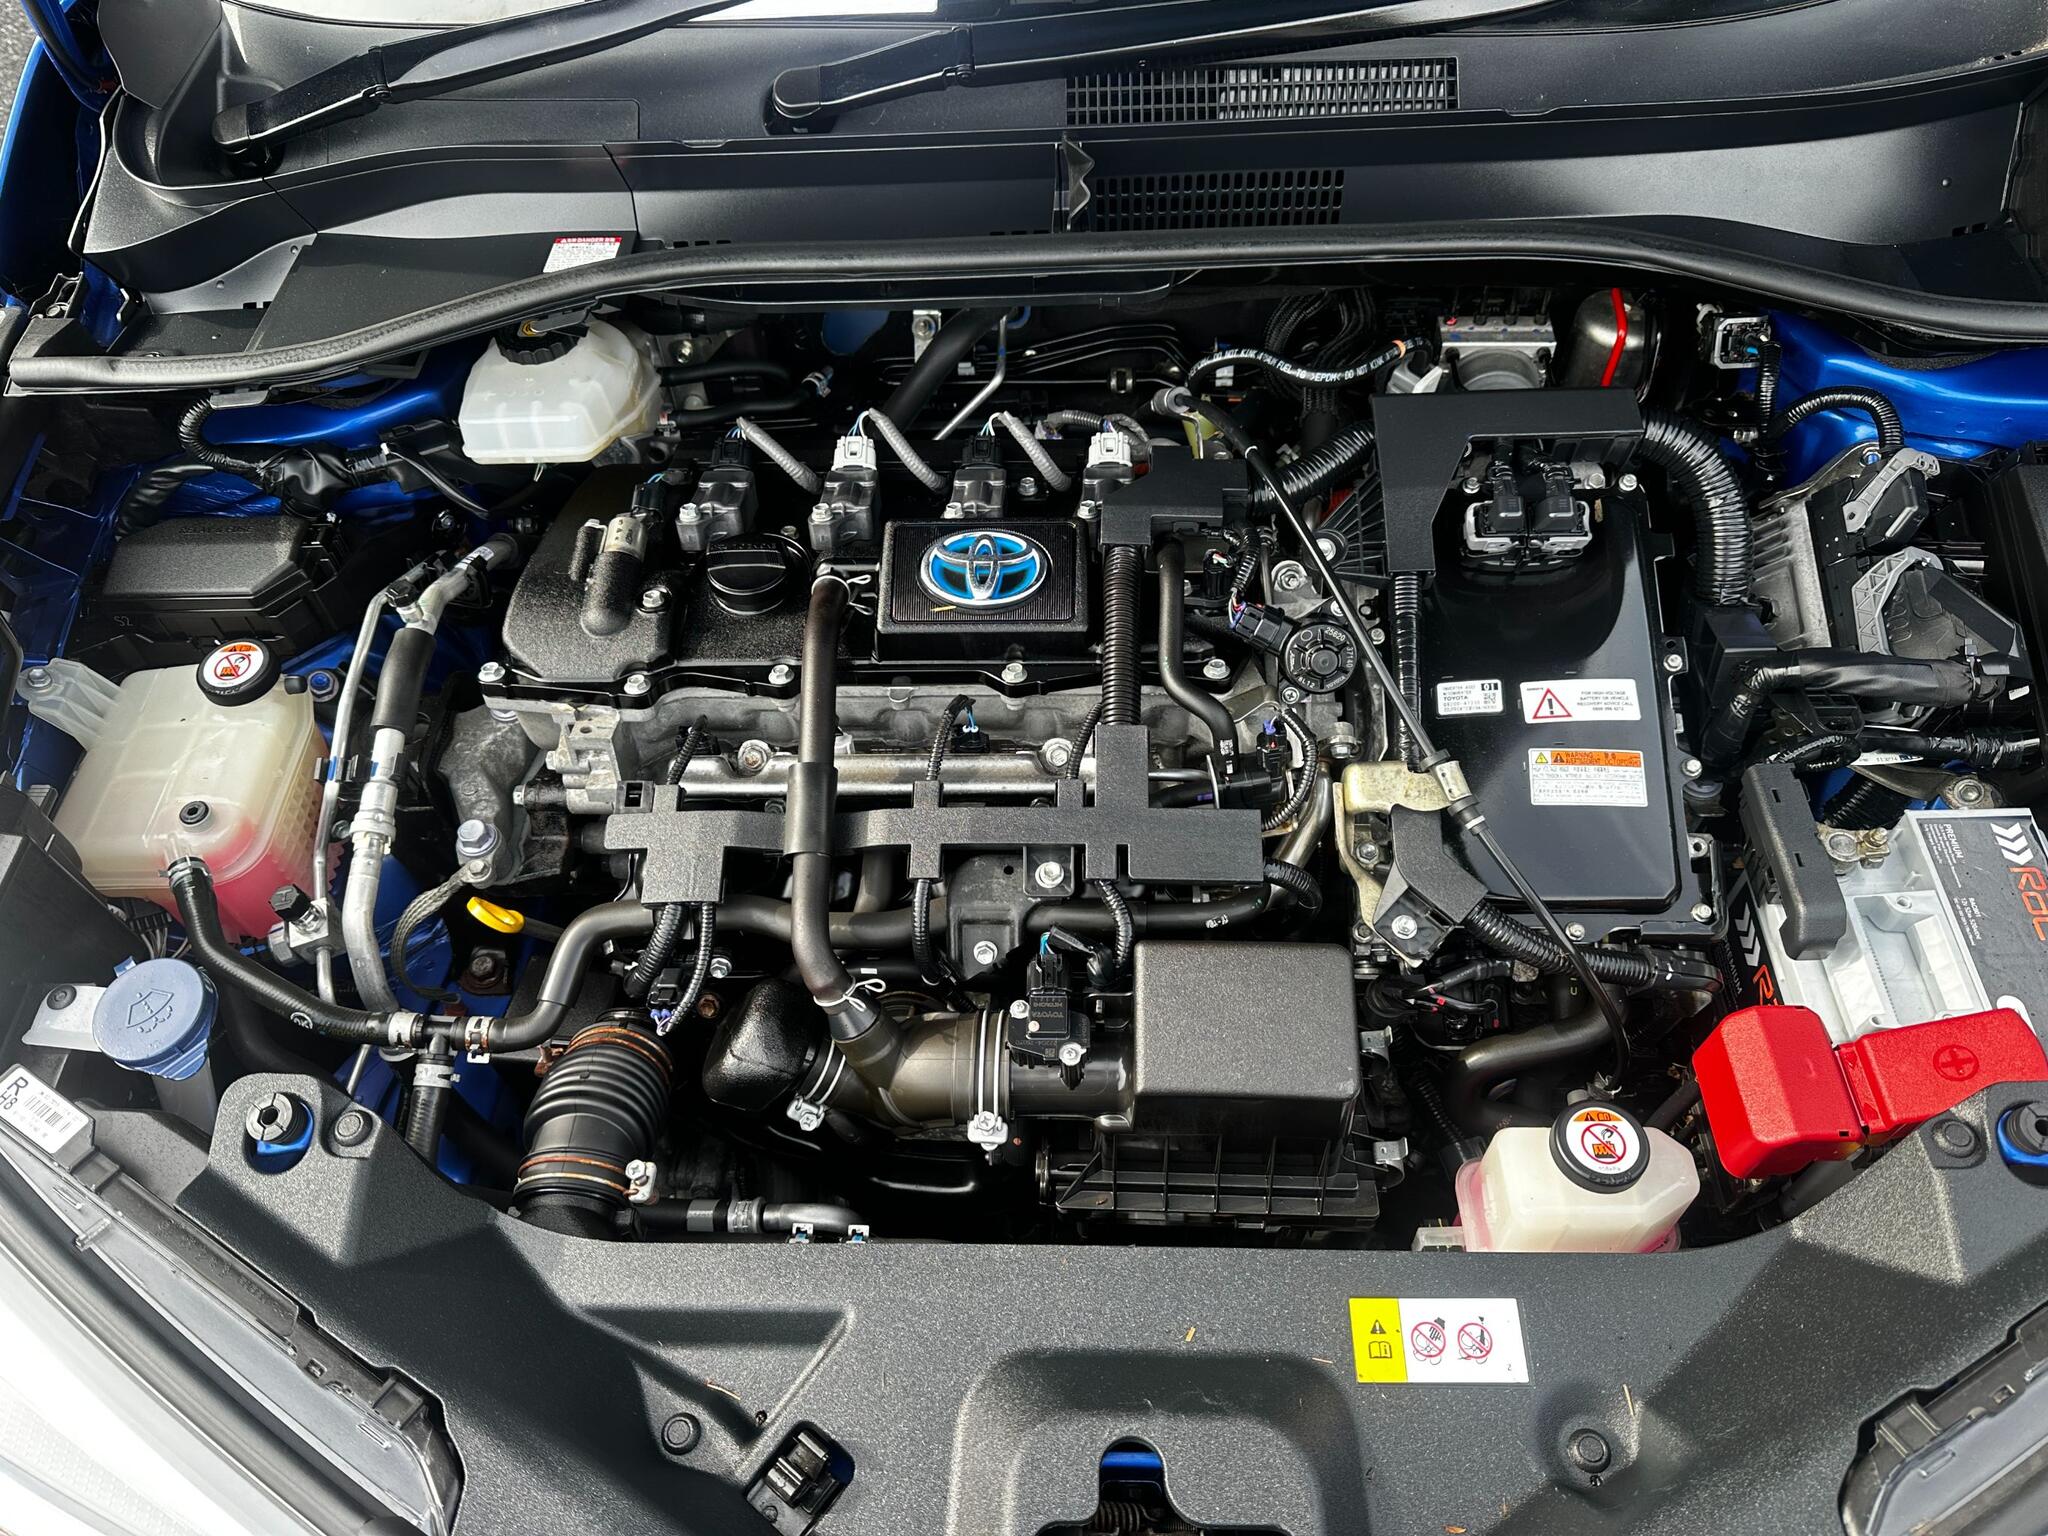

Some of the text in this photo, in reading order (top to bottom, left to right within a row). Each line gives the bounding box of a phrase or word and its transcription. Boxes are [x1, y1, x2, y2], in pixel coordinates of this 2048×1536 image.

[1213, 351, 1223, 361] DO
[1224, 348, 1239, 359] NOT
[1240, 348, 1258, 359] KINK
[1344, 370, 1355, 380] DO
[1356, 364, 1368, 376] NOT
[1324, 626, 1346, 641] 25620
[1346, 646, 1354, 668] 37140
[1942, 823, 1964, 857] PREMIUM
[7, 1077, 29, 1096] R
